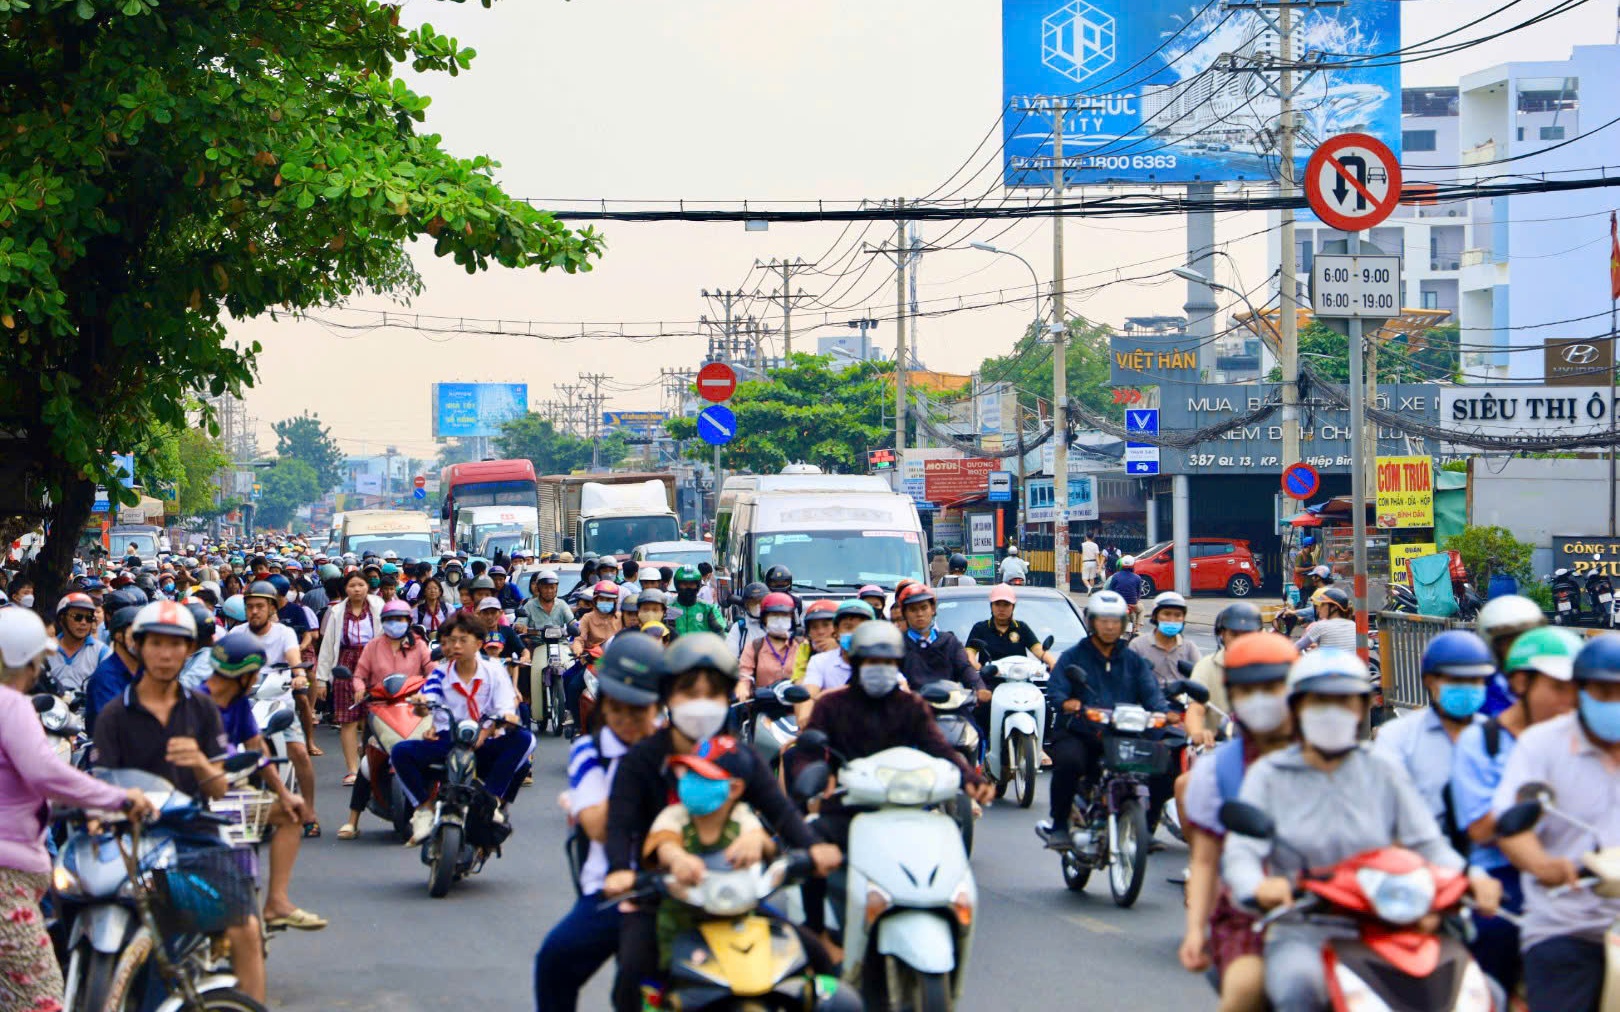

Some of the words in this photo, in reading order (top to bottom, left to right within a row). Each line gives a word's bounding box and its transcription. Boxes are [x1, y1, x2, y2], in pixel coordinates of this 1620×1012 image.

[1090, 156, 1130, 169] 1800
[1132, 155, 1176, 169] 6363
[1324, 268, 1348, 282] 6:00
[1363, 268, 1389, 283] 9:00
[1321, 293, 1349, 308] 16:00
[1362, 293, 1393, 309] 19:00
[1116, 347, 1154, 372] VIỆT
[1158, 348, 1196, 369] HÀN
[1188, 397, 1239, 413] MUA,
[1400, 396, 1425, 411] XE
[1452, 391, 1518, 421] SIÊU
[1526, 397, 1578, 425] THỊ
[1586, 391, 1606, 420] Ô
[1189, 454, 1216, 466] 387
[1218, 456, 1235, 466] QL
[1240, 456, 1256, 468] 13,
[1260, 456, 1279, 466] KP.
[1306, 455, 1333, 468] Hiệp
[1335, 454, 1363, 466] Bìn
[1377, 461, 1401, 493] CƠM
[1402, 460, 1431, 492] TRƯA
[1563, 541, 1606, 554] CÔNG
